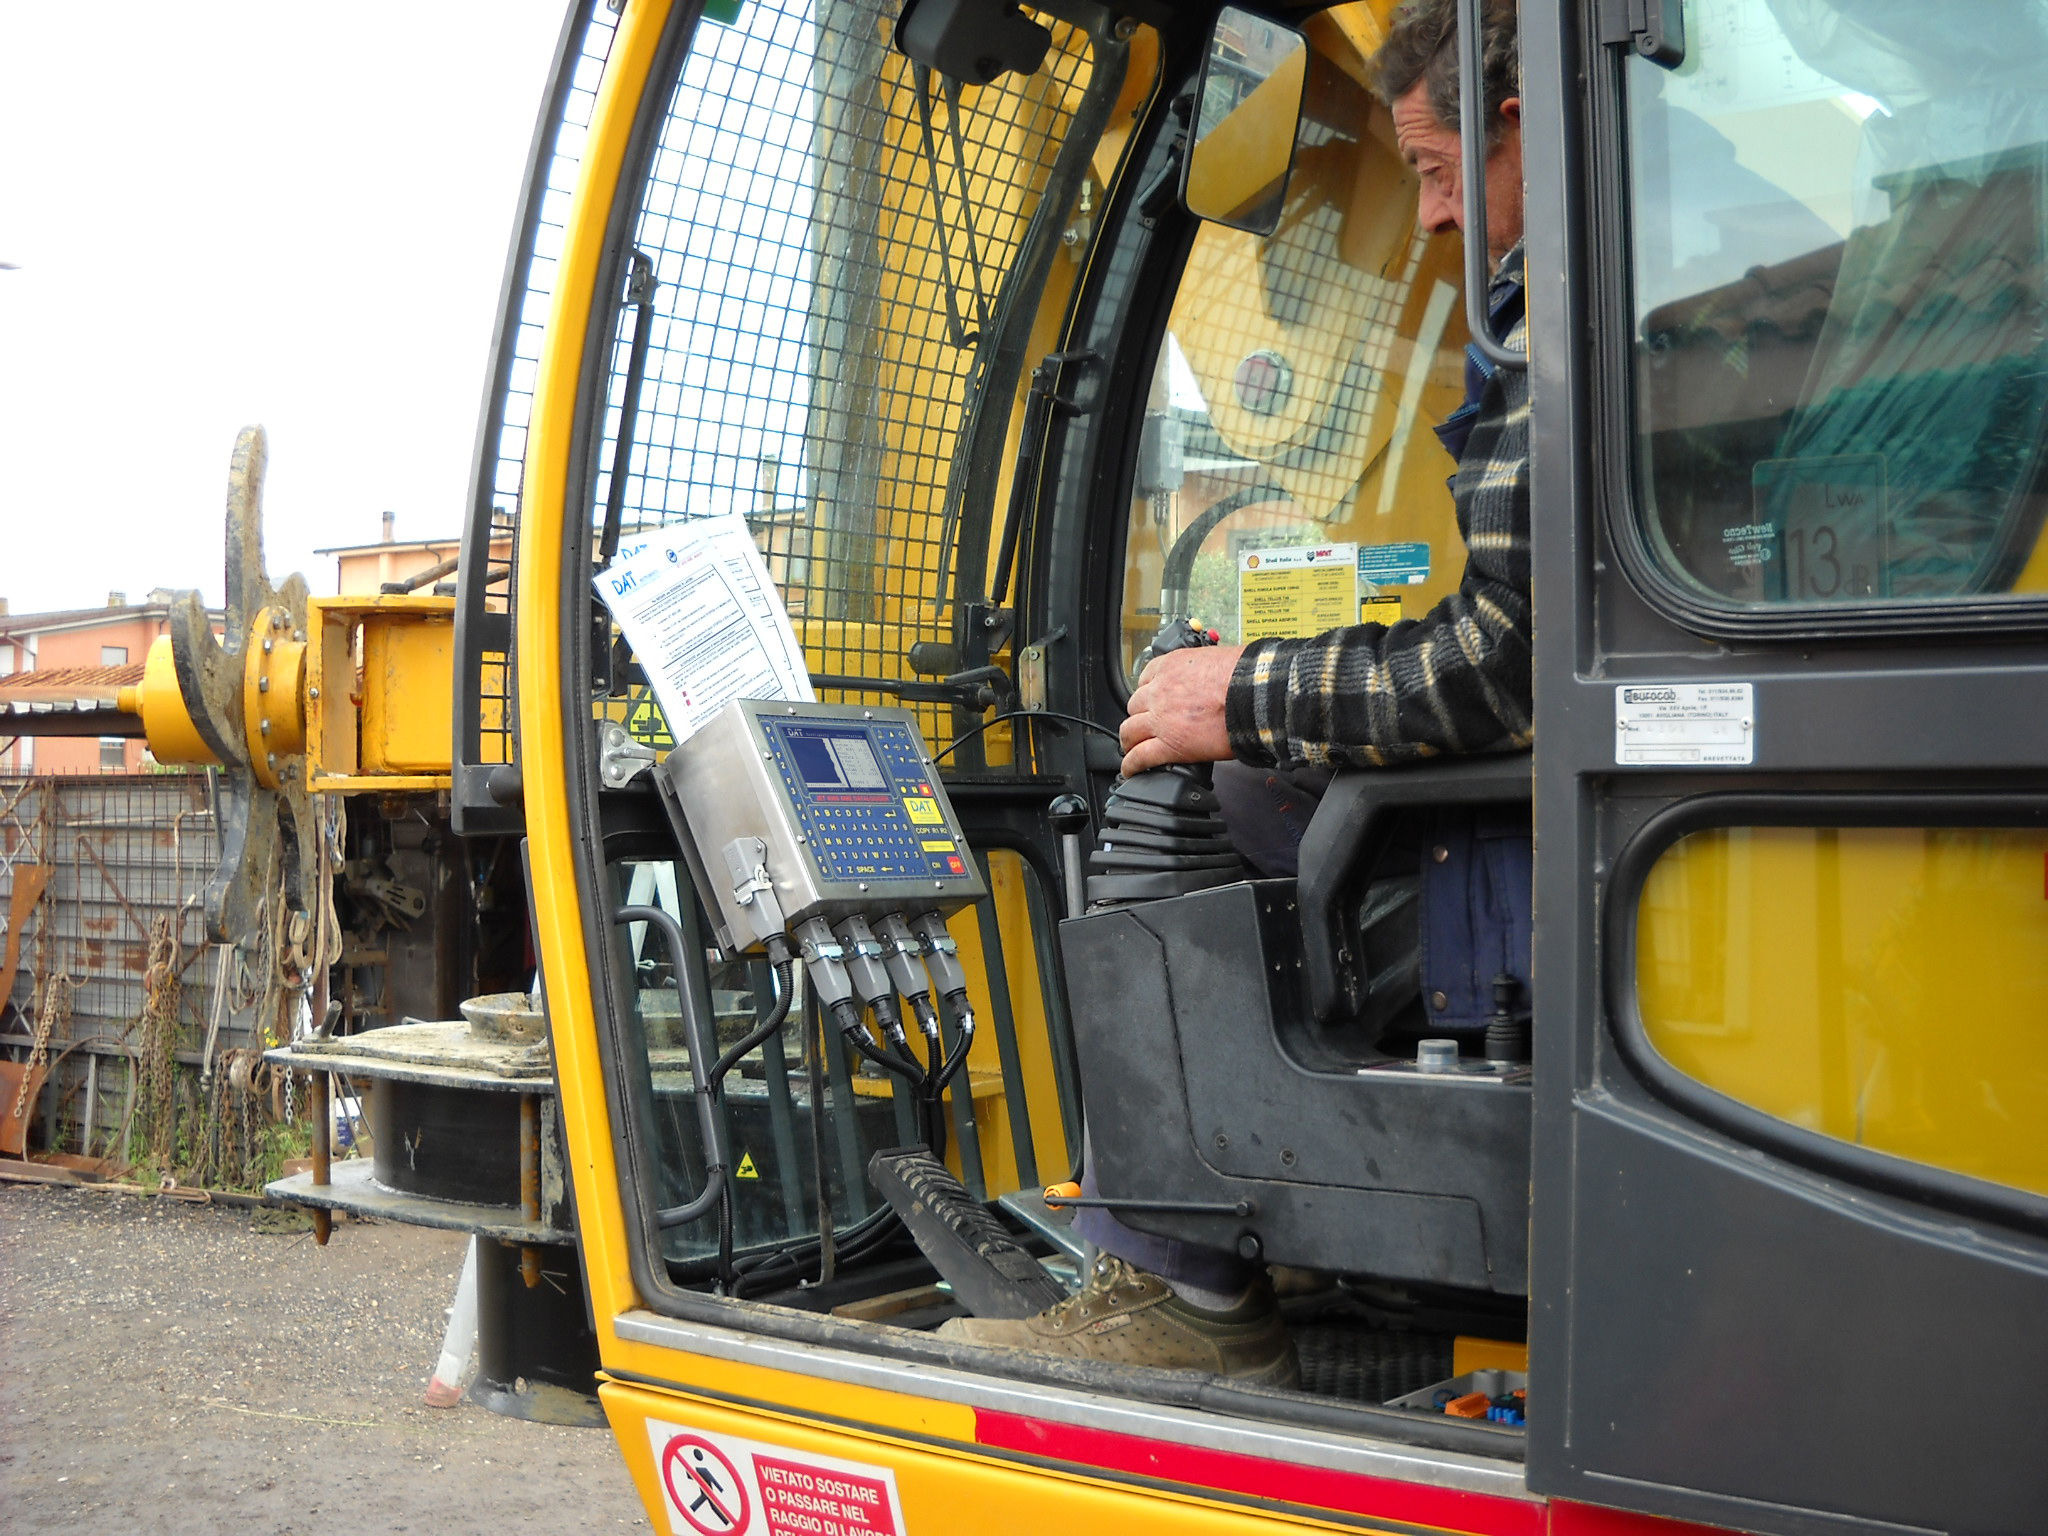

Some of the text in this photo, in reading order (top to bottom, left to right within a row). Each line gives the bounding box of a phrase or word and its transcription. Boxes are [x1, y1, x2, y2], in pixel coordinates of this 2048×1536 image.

[611, 571, 638, 595] DAT
[910, 801, 932, 812] DAT
[760, 1465, 880, 1505] VIETATO SOSTARE
[765, 1486, 871, 1523] O PASSARE NEL
[770, 1507, 822, 1533] RAGGIO
[823, 1520, 839, 1536] DI
